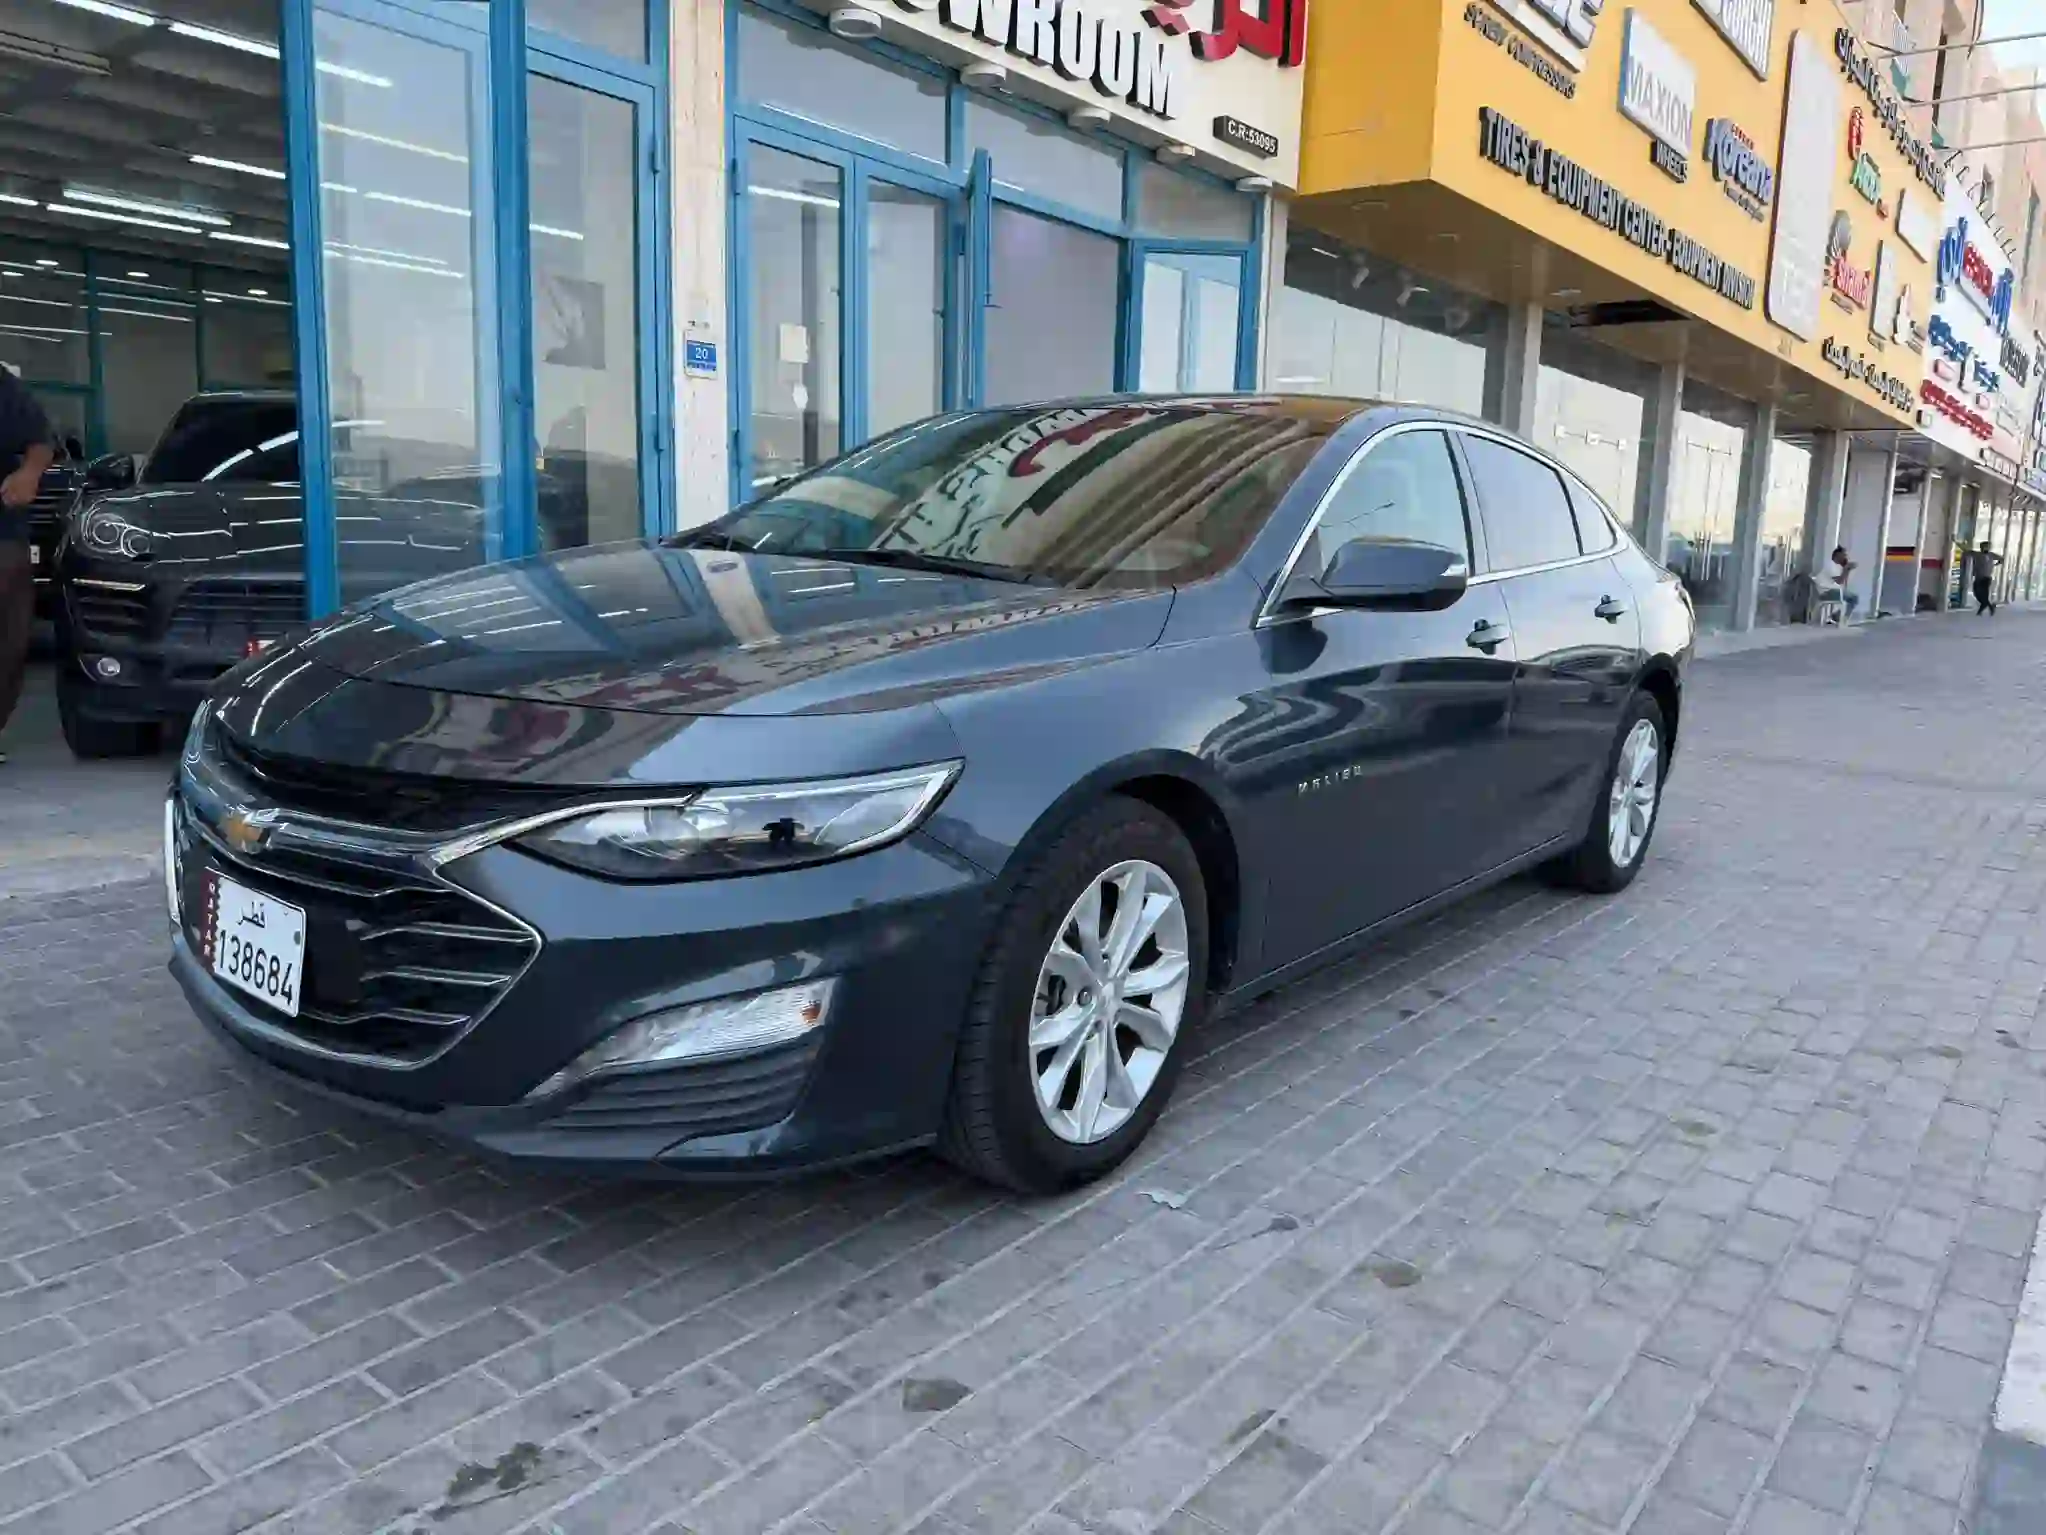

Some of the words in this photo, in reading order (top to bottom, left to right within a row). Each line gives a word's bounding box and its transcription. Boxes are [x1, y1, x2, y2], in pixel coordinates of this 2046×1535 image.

[1624, 55, 1691, 143] MAXION
[1228, 120, 1276, 153] C.R:53095
[1655, 140, 1688, 182] WHEELS
[1481, 105, 1530, 177] TIRES
[1529, 139, 1544, 186] &
[1545, 149, 1622, 233] EQUIPMENT
[1671, 229, 1721, 292] EQUIPMENT
[1720, 262, 1756, 310] DIVISION
[695, 347, 709, 360] 20
[236, 901, 267, 929] قطر
[217, 929, 294, 1007] 138684
